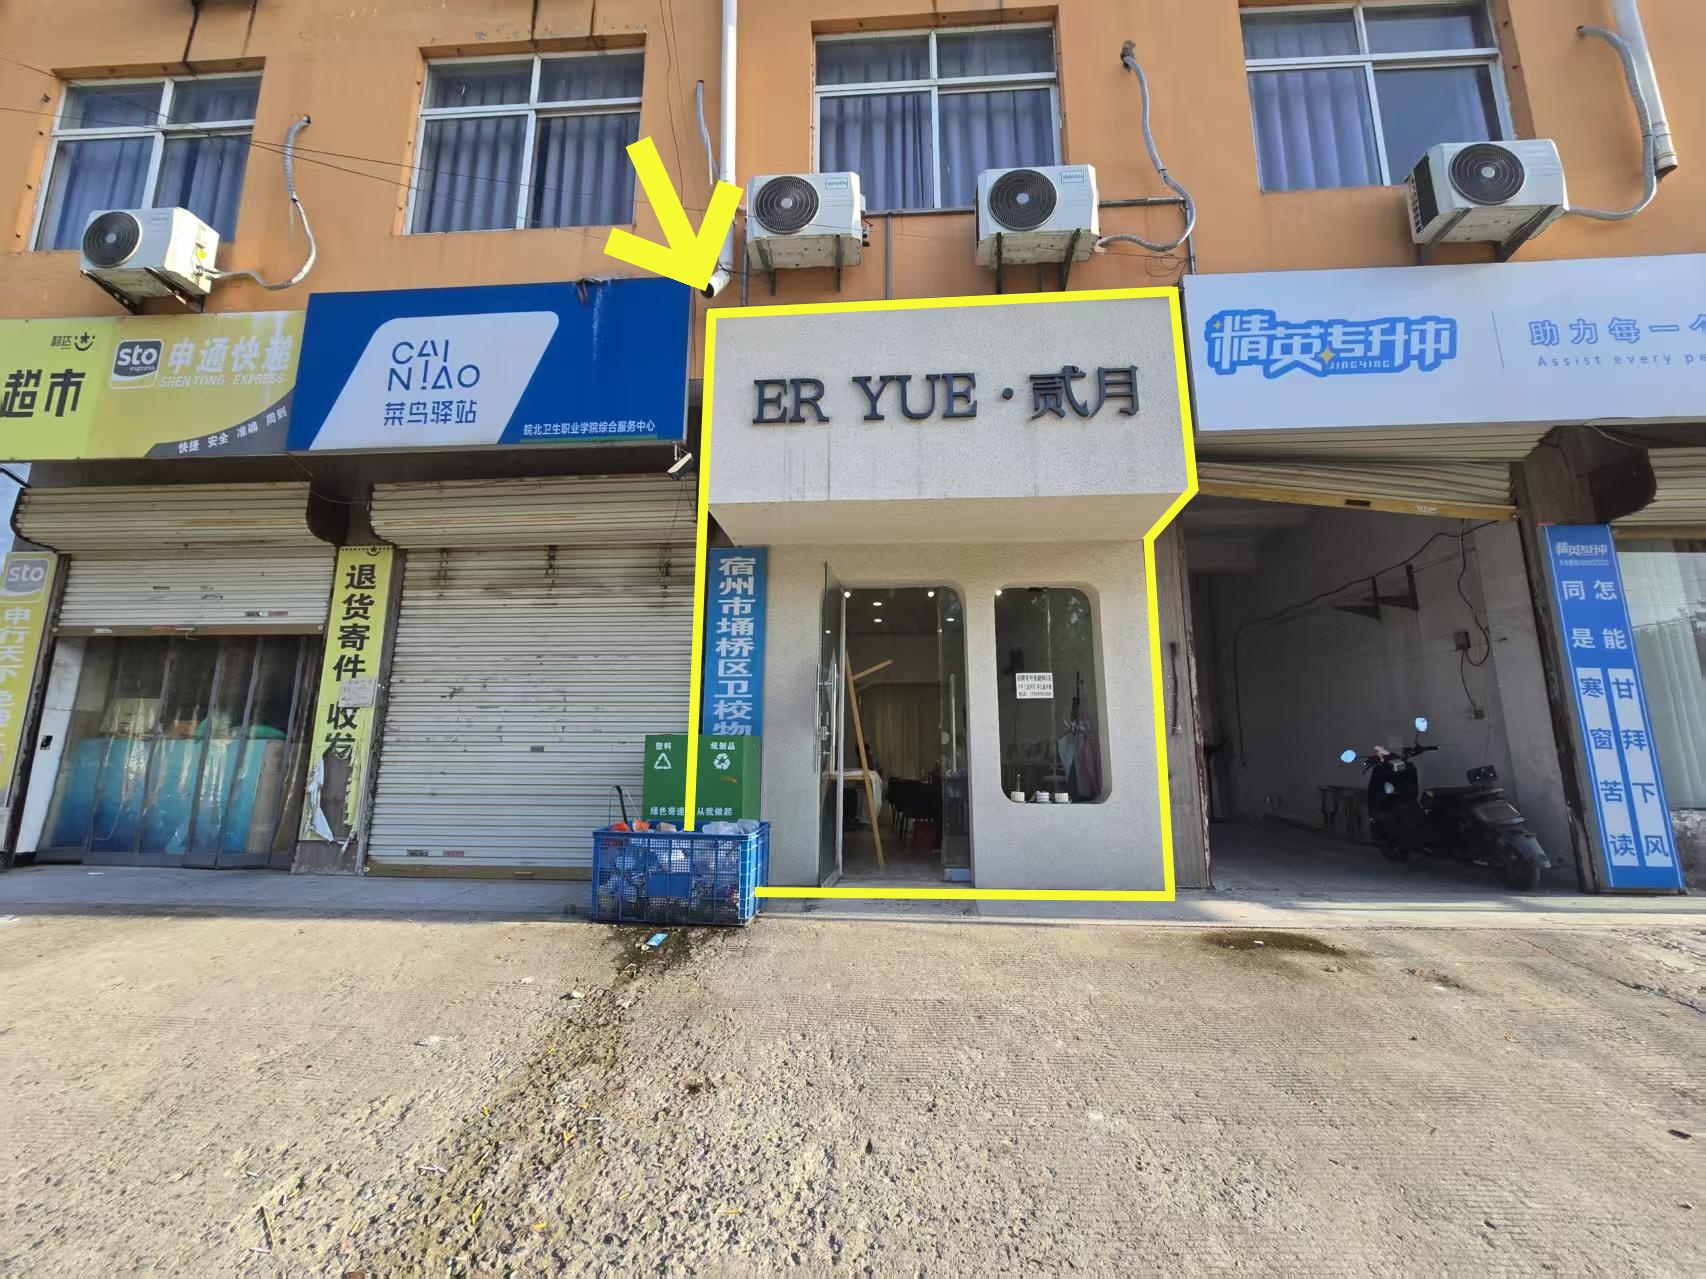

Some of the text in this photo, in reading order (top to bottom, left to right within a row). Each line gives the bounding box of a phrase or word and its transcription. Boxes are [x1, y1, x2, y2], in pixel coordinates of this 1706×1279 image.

[392, 339, 449, 365] CAI
[1211, 314, 1450, 373] 精英专升本
[117, 345, 157, 366] sto
[1537, 355, 1602, 368] Assist
[1614, 354, 1671, 367] every
[1328, 360, 1392, 371] JINGYING
[160, 372, 285, 388] SHEN TONG EXPRESS
[0, 369, 86, 419] 超市
[752, 378, 830, 424] ER
[852, 372, 979, 421] YUE
[1029, 365, 1138, 420] 贰月
[383, 399, 478, 426] 菜鸟驿站
[178, 406, 287, 454] 快捷 安全 准确 周到
[523, 420, 656, 436] 皖北卫生职业学院综合服务中心
[8, 564, 44, 582] sto
[332, 564, 377, 682] 退货寄件
[655, 742, 672, 751] 塑料
[710, 741, 736, 751] 纸制品
[696, 807, 733, 816] 从我做起
